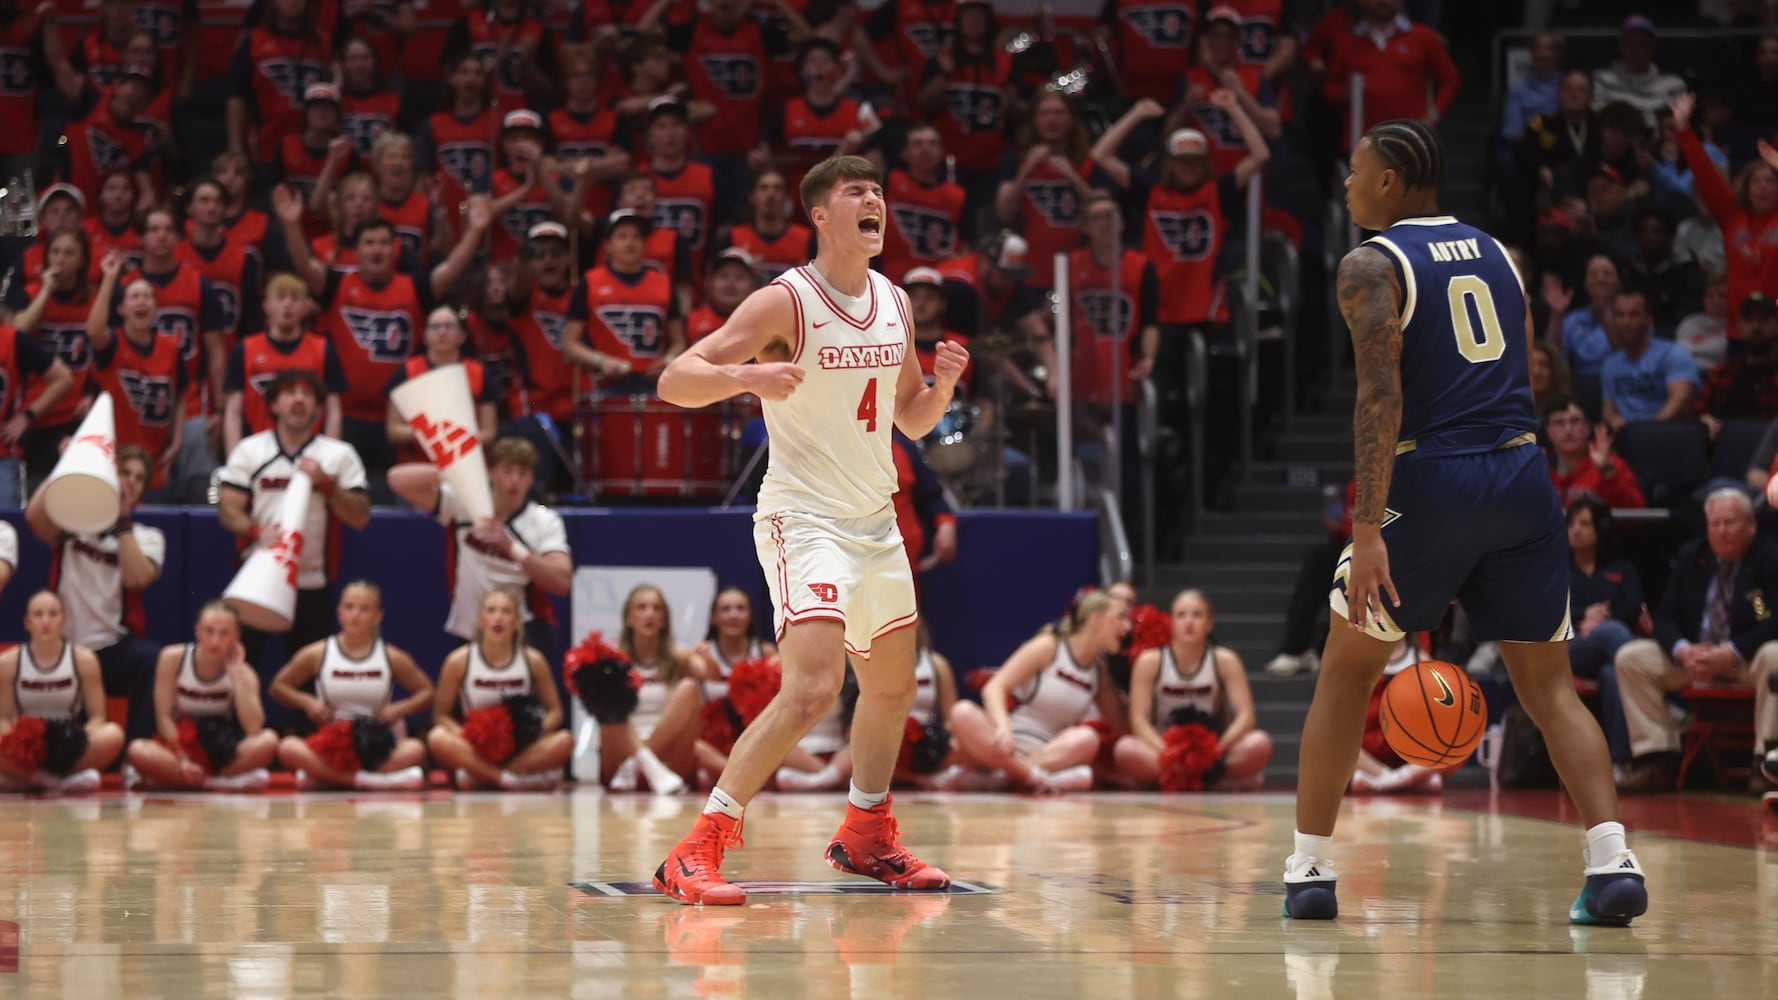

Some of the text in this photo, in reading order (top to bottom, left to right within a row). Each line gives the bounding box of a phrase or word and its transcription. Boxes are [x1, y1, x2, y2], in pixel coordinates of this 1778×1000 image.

[1427, 237, 1482, 262] AUTRY
[1447, 275, 1506, 363] 0
[818, 343, 904, 370] DAYTON
[857, 378, 877, 432] 4
